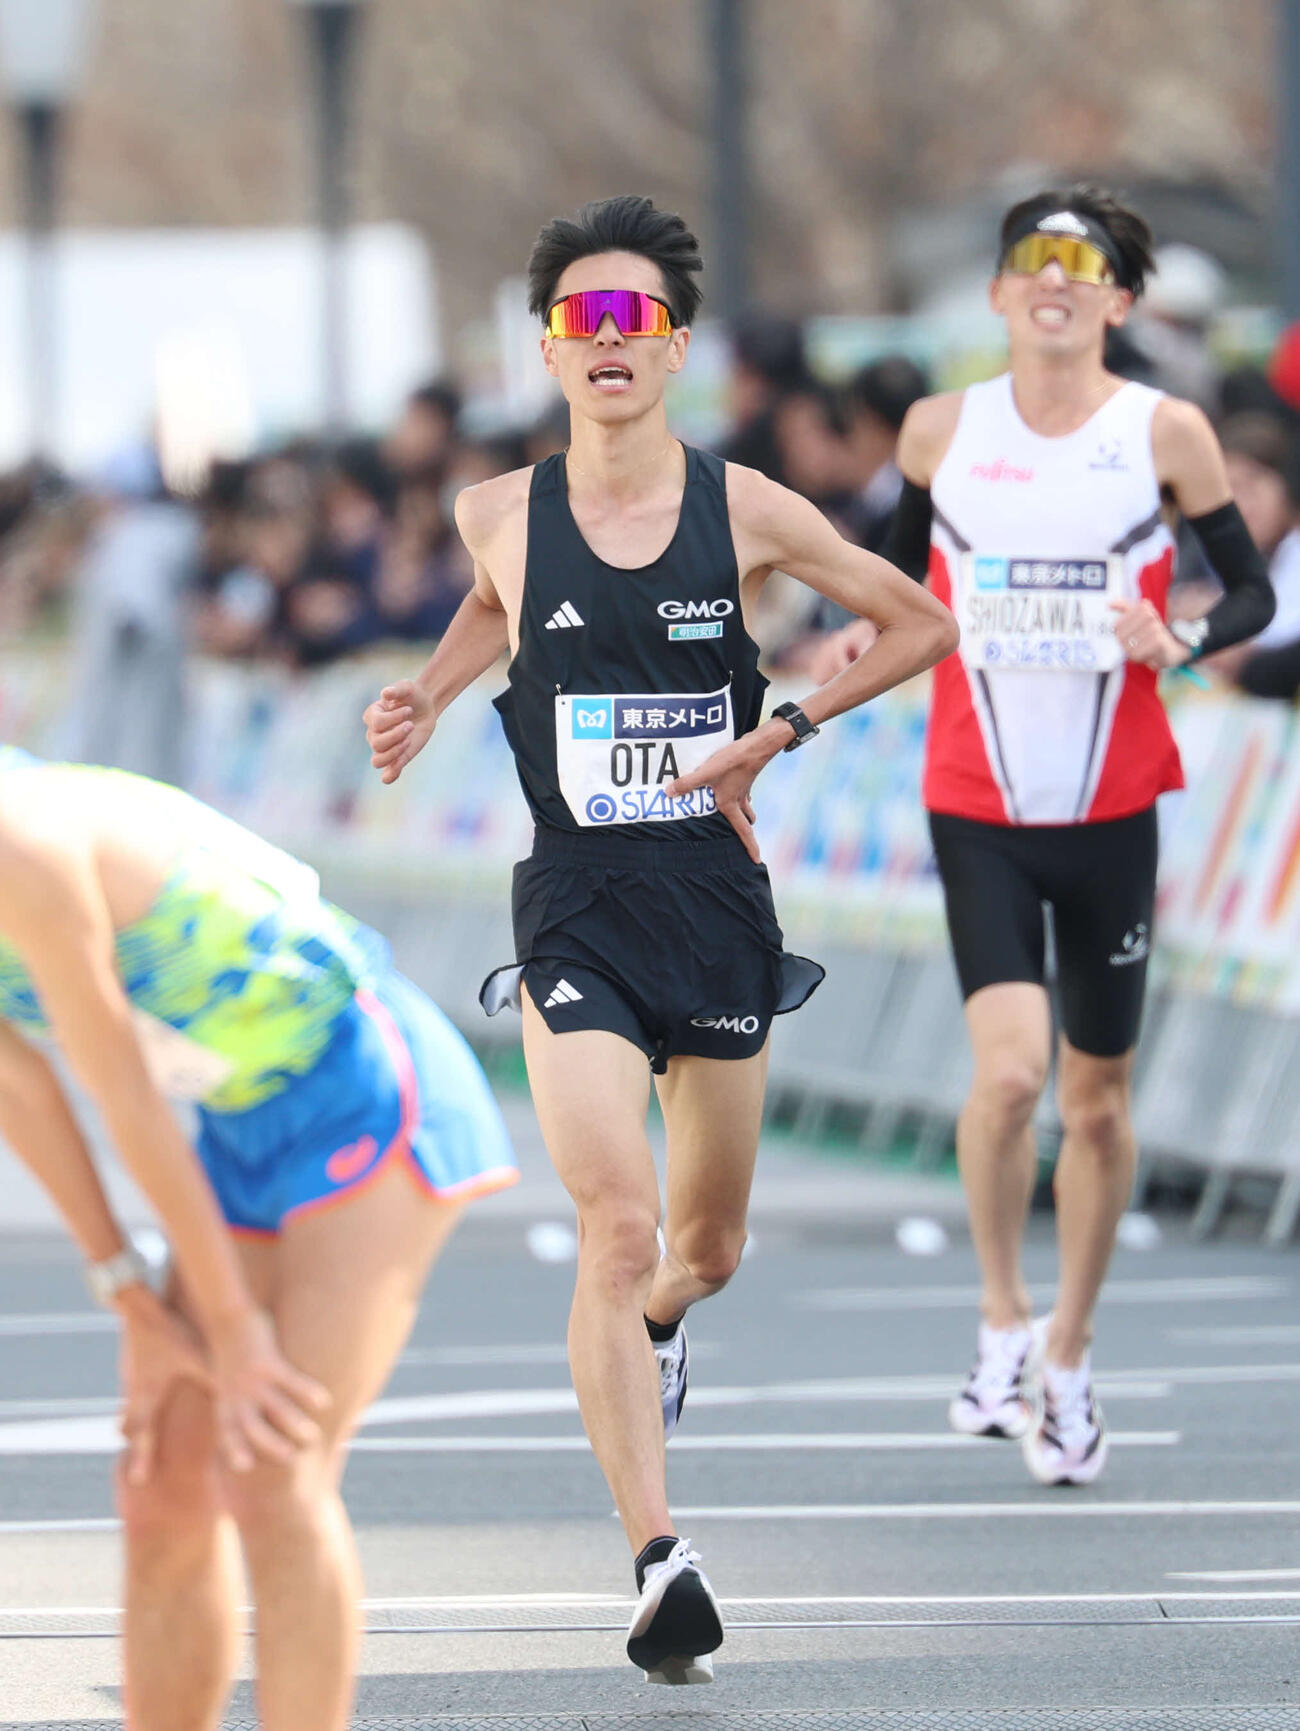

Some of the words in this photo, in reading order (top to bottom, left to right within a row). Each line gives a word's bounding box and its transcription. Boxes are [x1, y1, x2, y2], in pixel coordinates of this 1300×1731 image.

[1011, 563, 1104, 586] 東京メトロ
[657, 599, 734, 619] GMO
[967, 595, 1085, 634] SHIOZAWA
[622, 704, 722, 728] 東京メトロ
[610, 742, 679, 787] OTA
[690, 1016, 759, 1034] GMO
